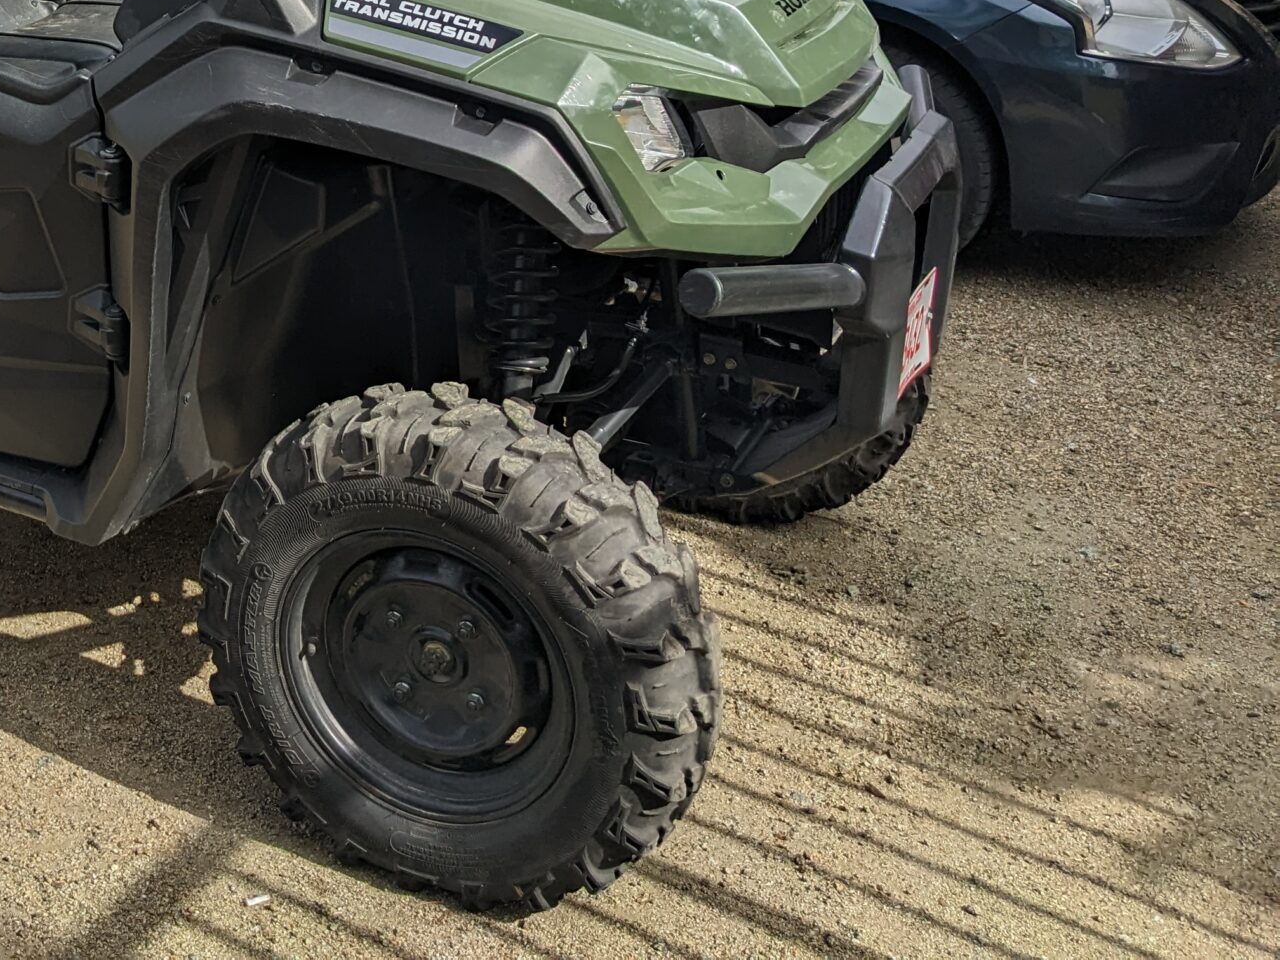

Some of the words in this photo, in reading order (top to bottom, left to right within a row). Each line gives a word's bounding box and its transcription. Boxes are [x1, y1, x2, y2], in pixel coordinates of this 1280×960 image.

[399, 1, 484, 31] CLUTCH
[244, 581, 265, 695] MASTER
[260, 705, 303, 765] DIRT
